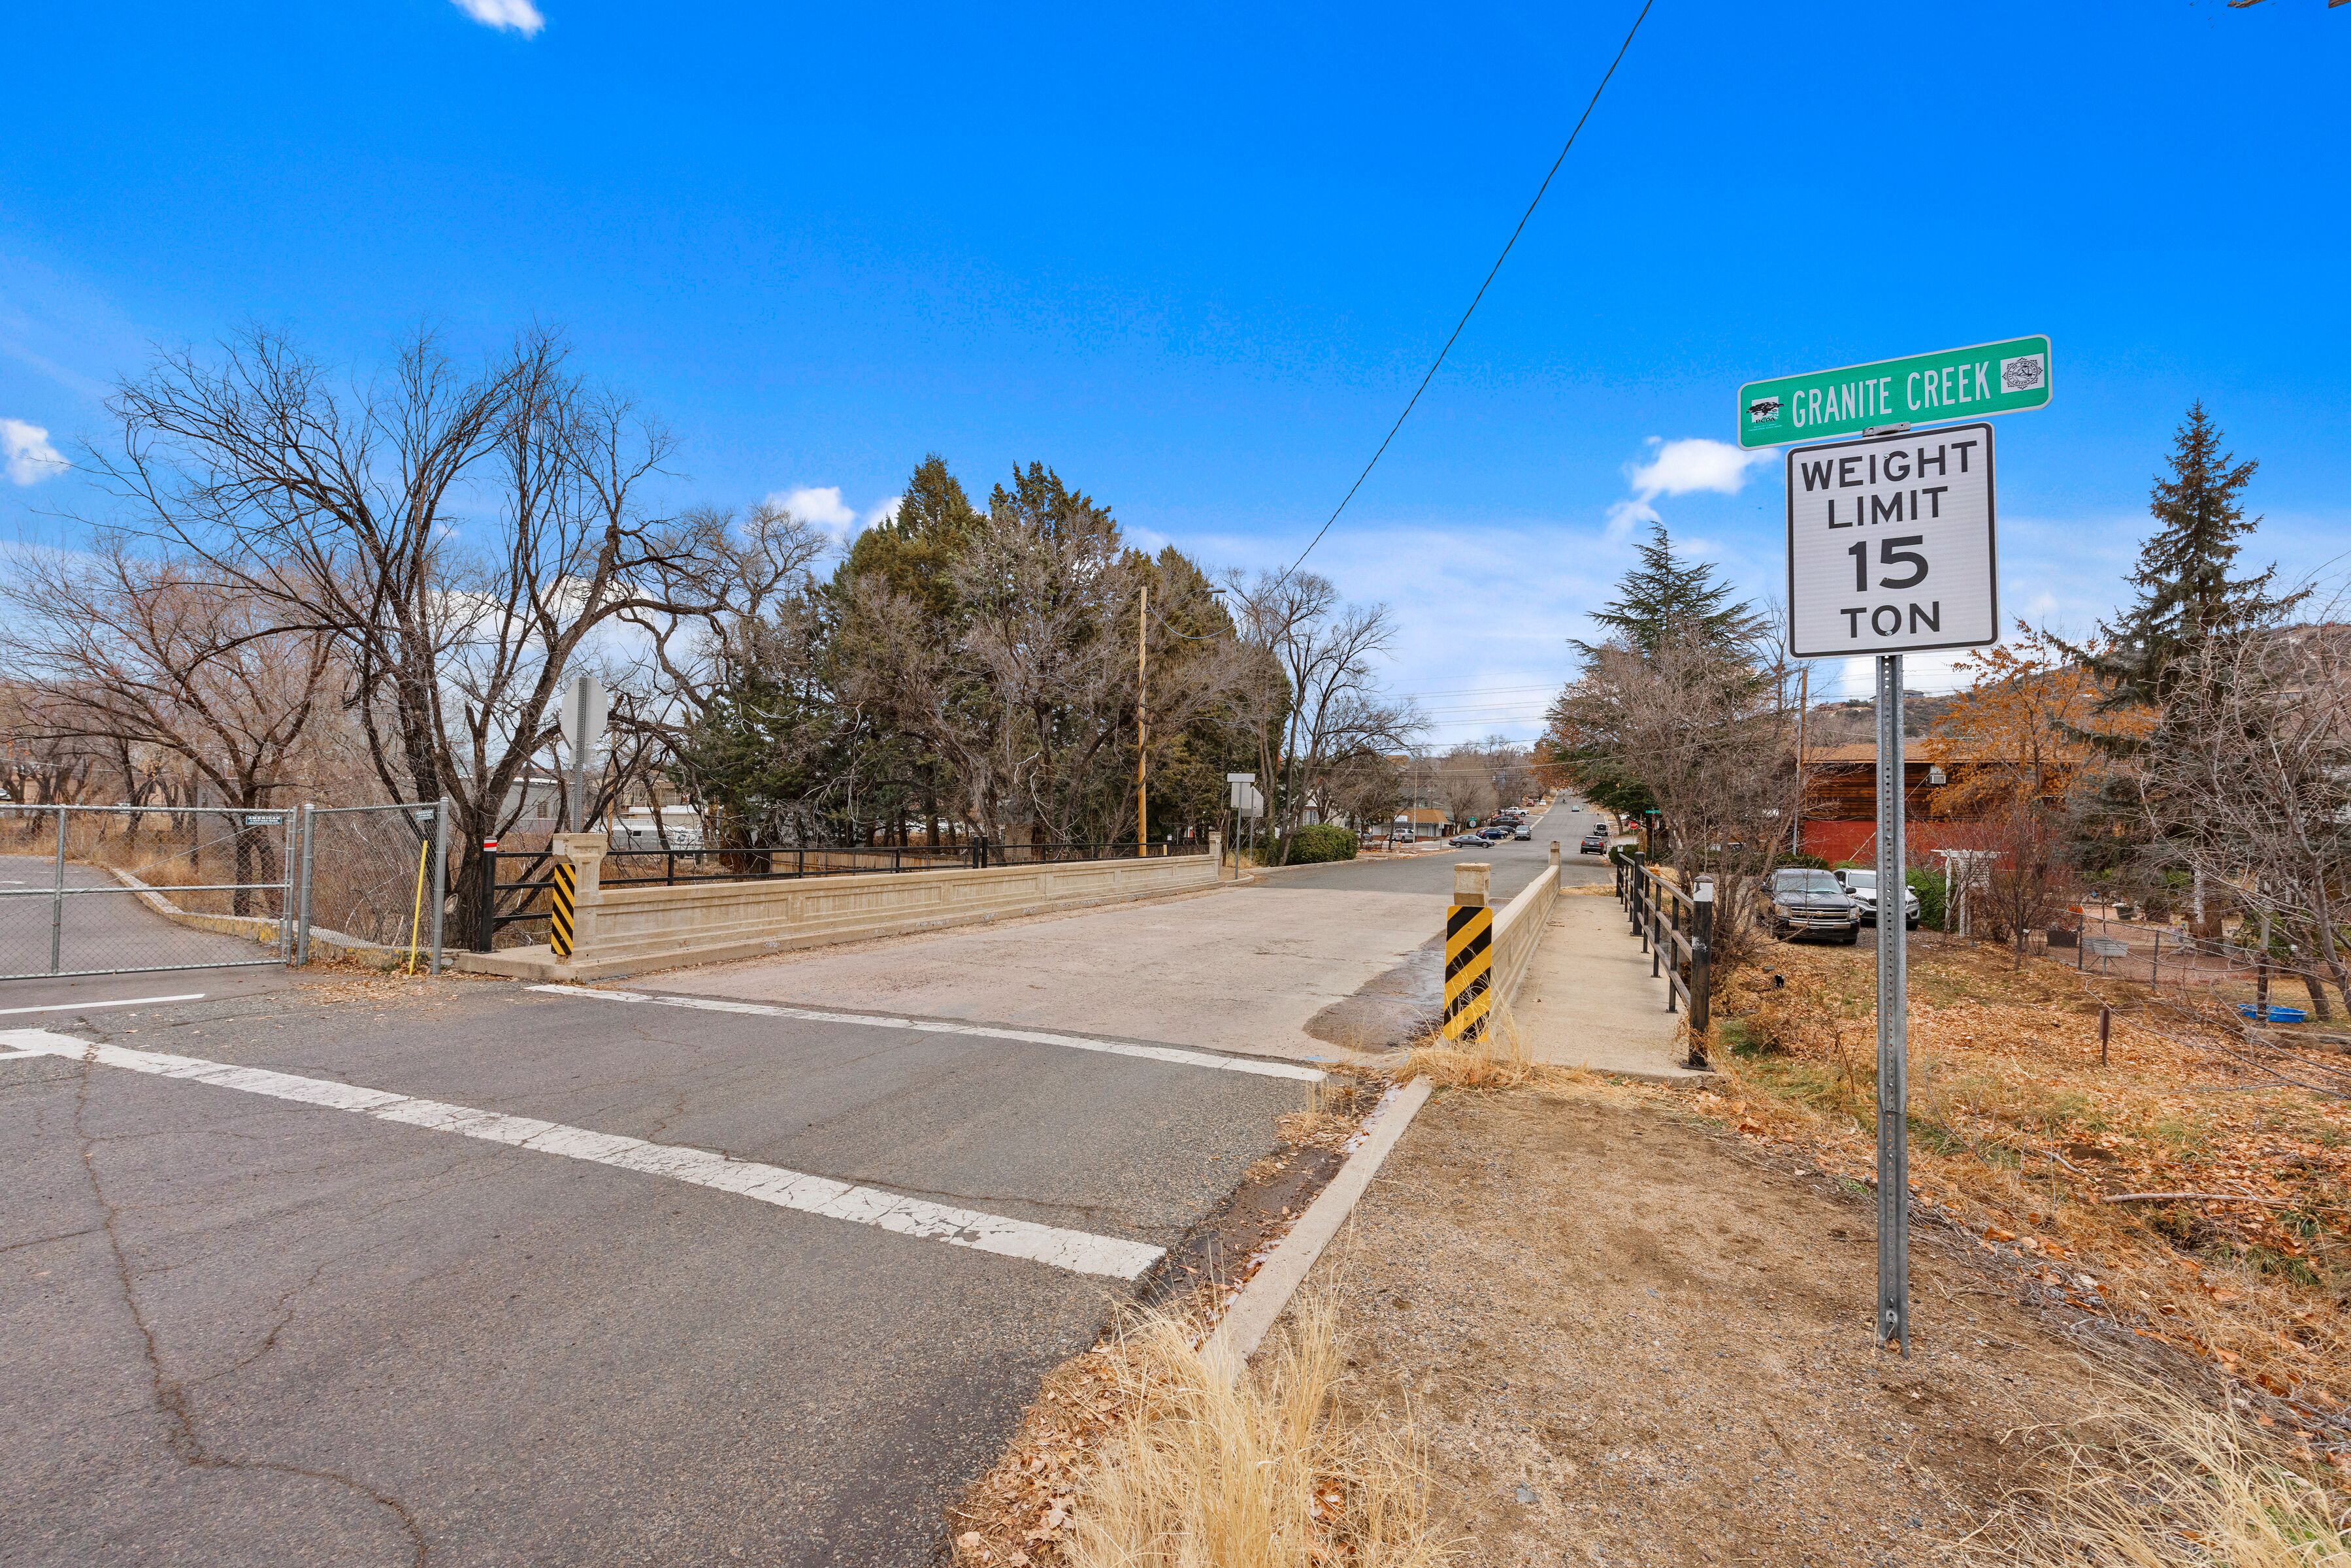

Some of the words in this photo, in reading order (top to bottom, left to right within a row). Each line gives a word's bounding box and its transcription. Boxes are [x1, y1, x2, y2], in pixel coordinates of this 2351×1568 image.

[1792, 377, 1892, 428] GRANITE
[1907, 361, 1991, 411] CREEK
[1801, 440, 1978, 491] WEIGHT
[1828, 486, 1948, 529] LIMIT
[1849, 535, 1928, 592] 15
[1840, 601, 1940, 638] TON
